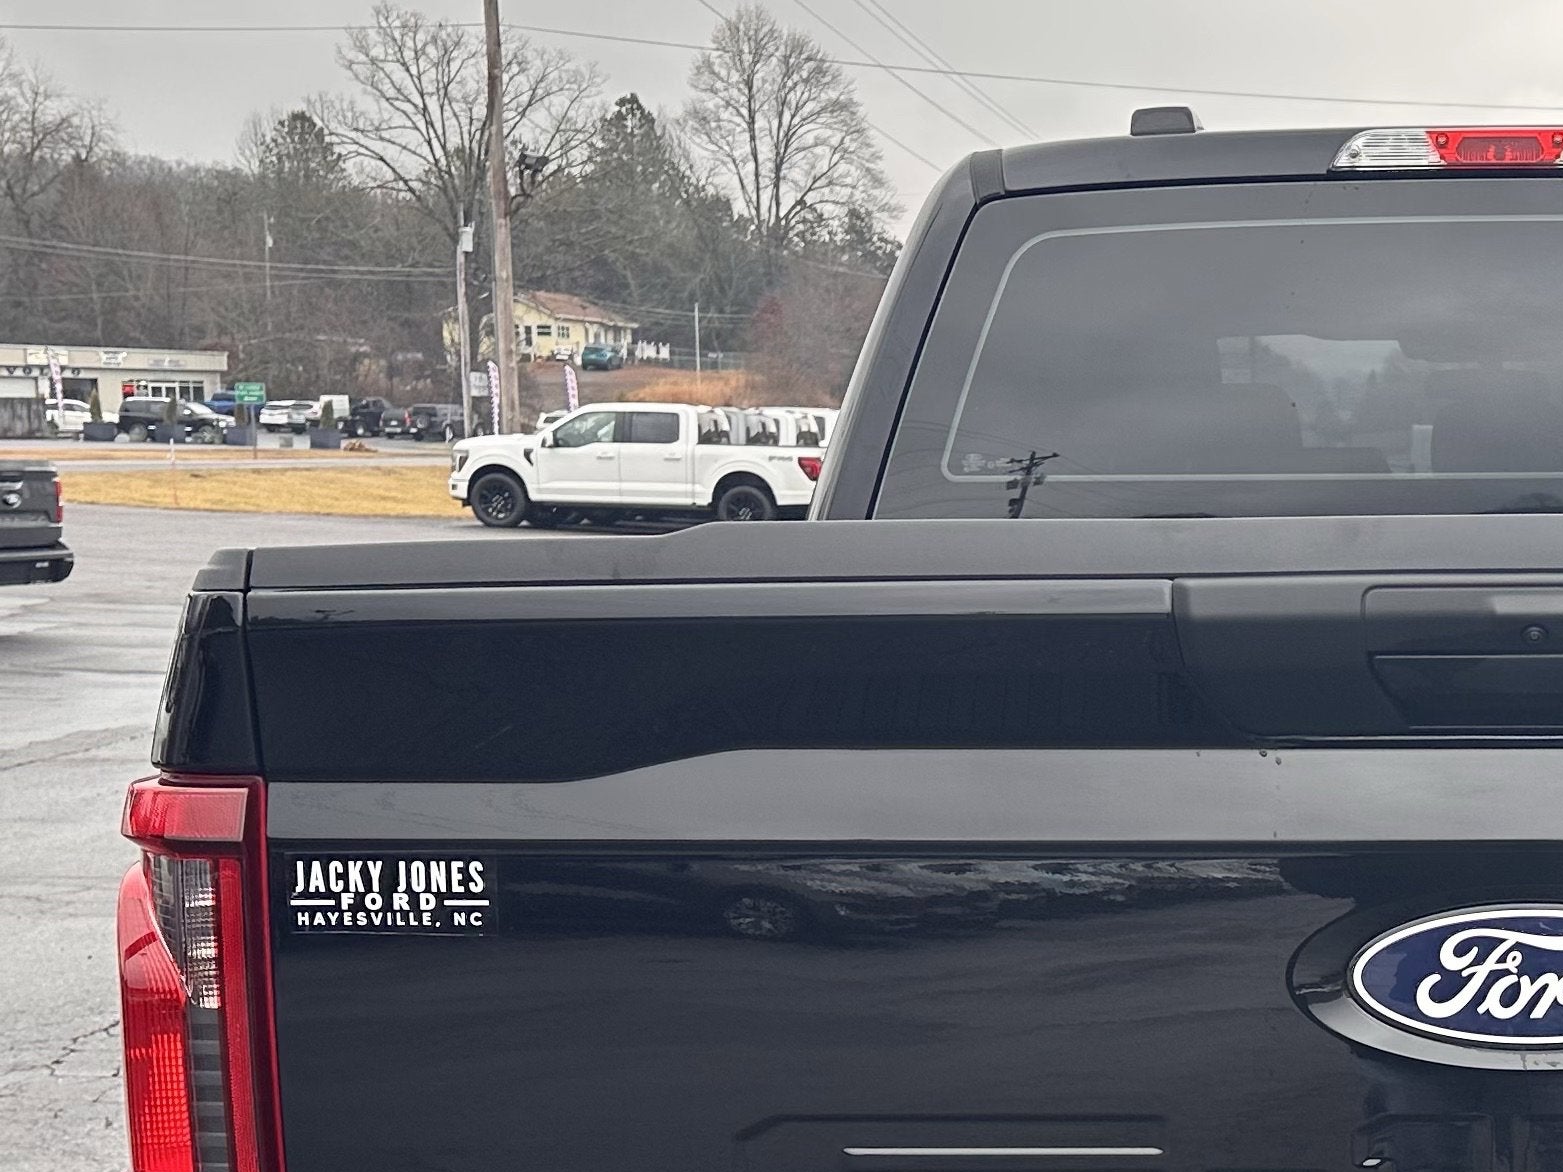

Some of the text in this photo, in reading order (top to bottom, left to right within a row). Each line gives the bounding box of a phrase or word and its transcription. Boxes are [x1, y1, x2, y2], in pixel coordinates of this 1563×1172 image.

[295, 860, 484, 893] JACKY JONES
[340, 892, 437, 911] FORD
[297, 911, 483, 928] HAYESVILLE, NC
